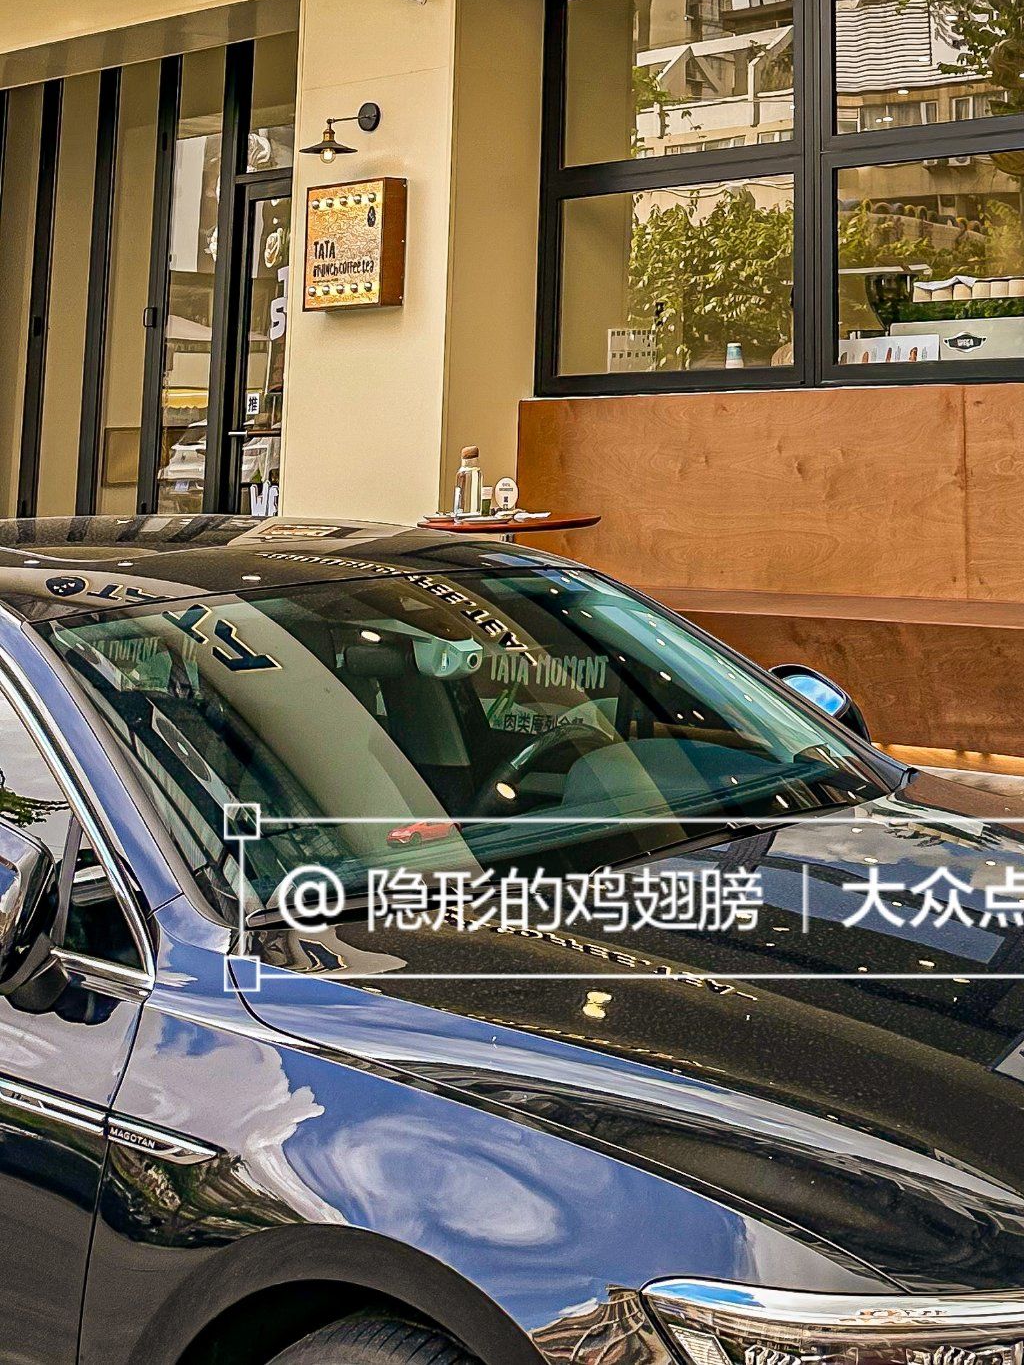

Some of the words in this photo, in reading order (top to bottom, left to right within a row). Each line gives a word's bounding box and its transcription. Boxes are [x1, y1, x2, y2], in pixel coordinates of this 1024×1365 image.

[248, 396, 258, 413] 推
[535, 654, 609, 693] MOMENT
[109, 1126, 156, 1149] MAGOTAN
